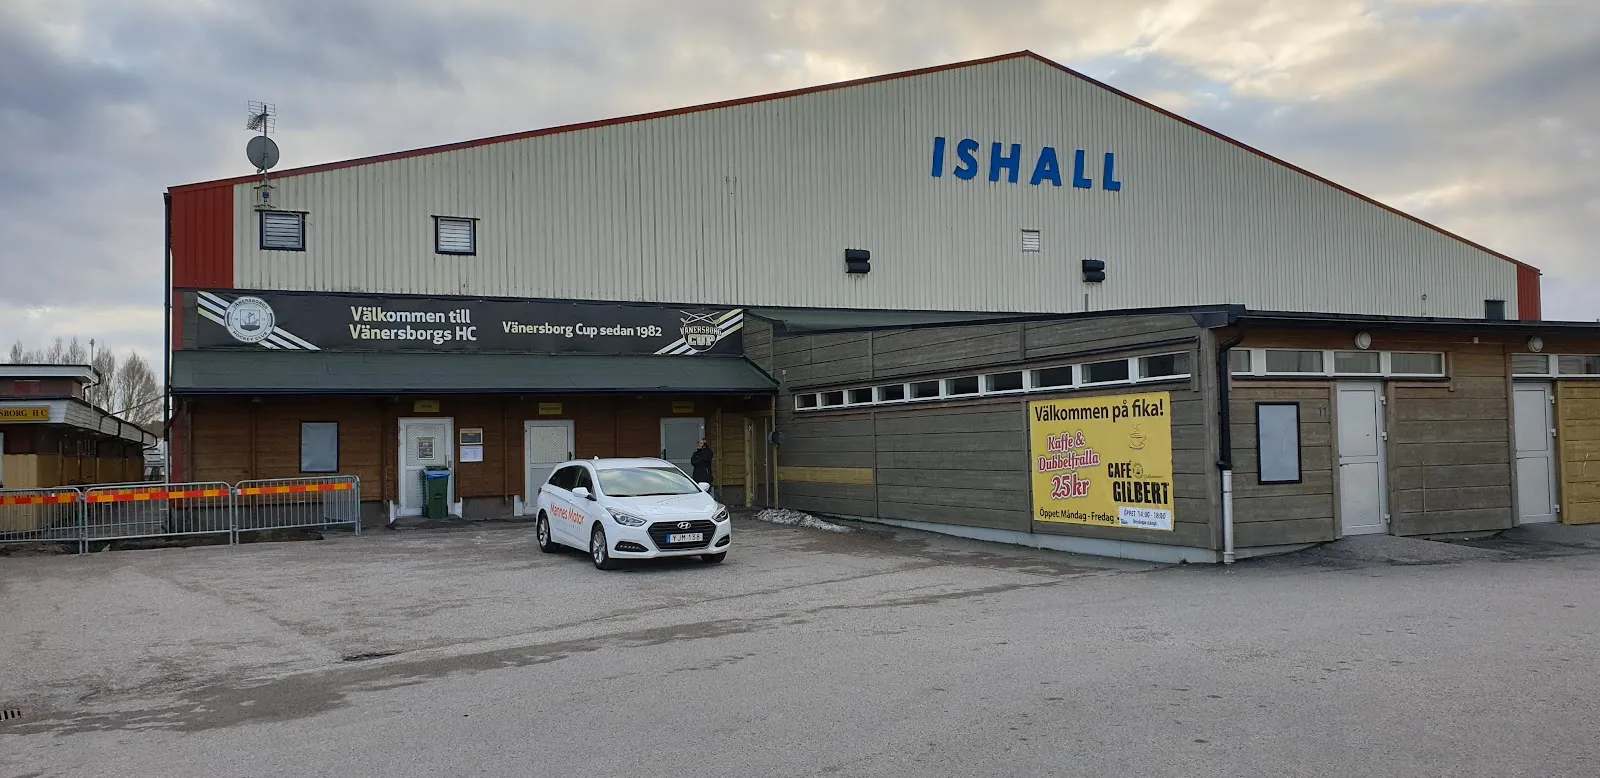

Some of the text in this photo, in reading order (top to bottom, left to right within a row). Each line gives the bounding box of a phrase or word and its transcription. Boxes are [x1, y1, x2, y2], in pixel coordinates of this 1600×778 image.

[931, 136, 1122, 192] ISHALL
[350, 306, 471, 323] Välkommen till
[232, 330, 254, 342] HOCKEY
[349, 324, 477, 345] Vänersborgs HC
[502, 321, 662, 338] Vänersborg Cup sedan 1982
[687, 334, 715, 346] CUP
[1035, 399, 1164, 422] Välkommen på fika!
[1047, 431, 1086, 452] Kaffe &
[1038, 449, 1100, 472] Dubbelfralla
[1107, 461, 1132, 479] CAFÉ
[1113, 481, 1170, 505] GILBERT
[550, 502, 568, 520] Mannes
[568, 507, 585, 527] Motor
[1039, 506, 1061, 520] Öppet:
[1060, 509, 1087, 522] Måndag
[1091, 511, 1115, 524] Fredag
[1123, 509, 1136, 517] ÖPPET
[1137, 510, 1150, 518] 14:00
[672, 533, 701, 542] YJM 138
